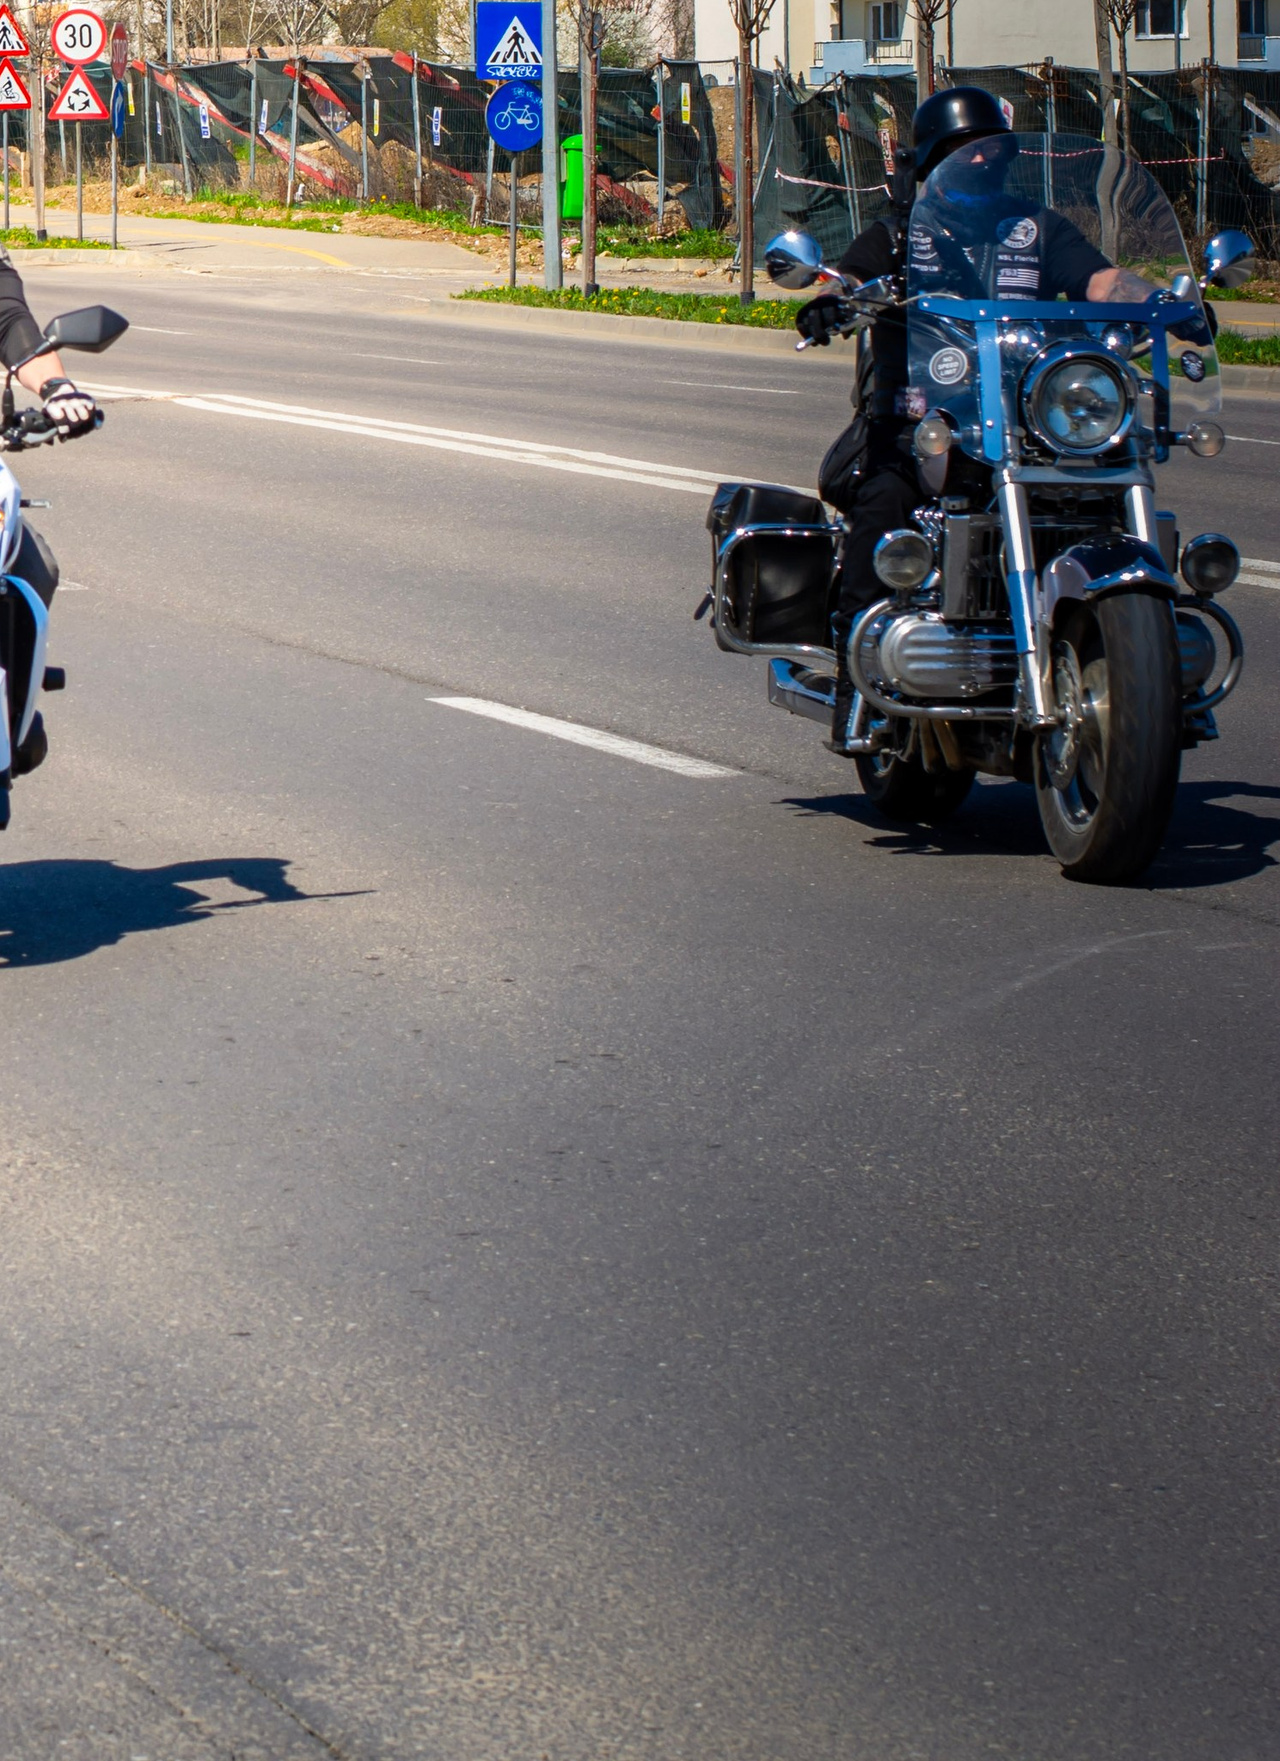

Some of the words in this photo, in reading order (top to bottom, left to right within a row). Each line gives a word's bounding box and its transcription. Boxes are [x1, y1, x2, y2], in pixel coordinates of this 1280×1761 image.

[64, 23, 92, 48] 30
[937, 361, 959, 370] SPEED
[940, 368, 957, 376] LIMIT
